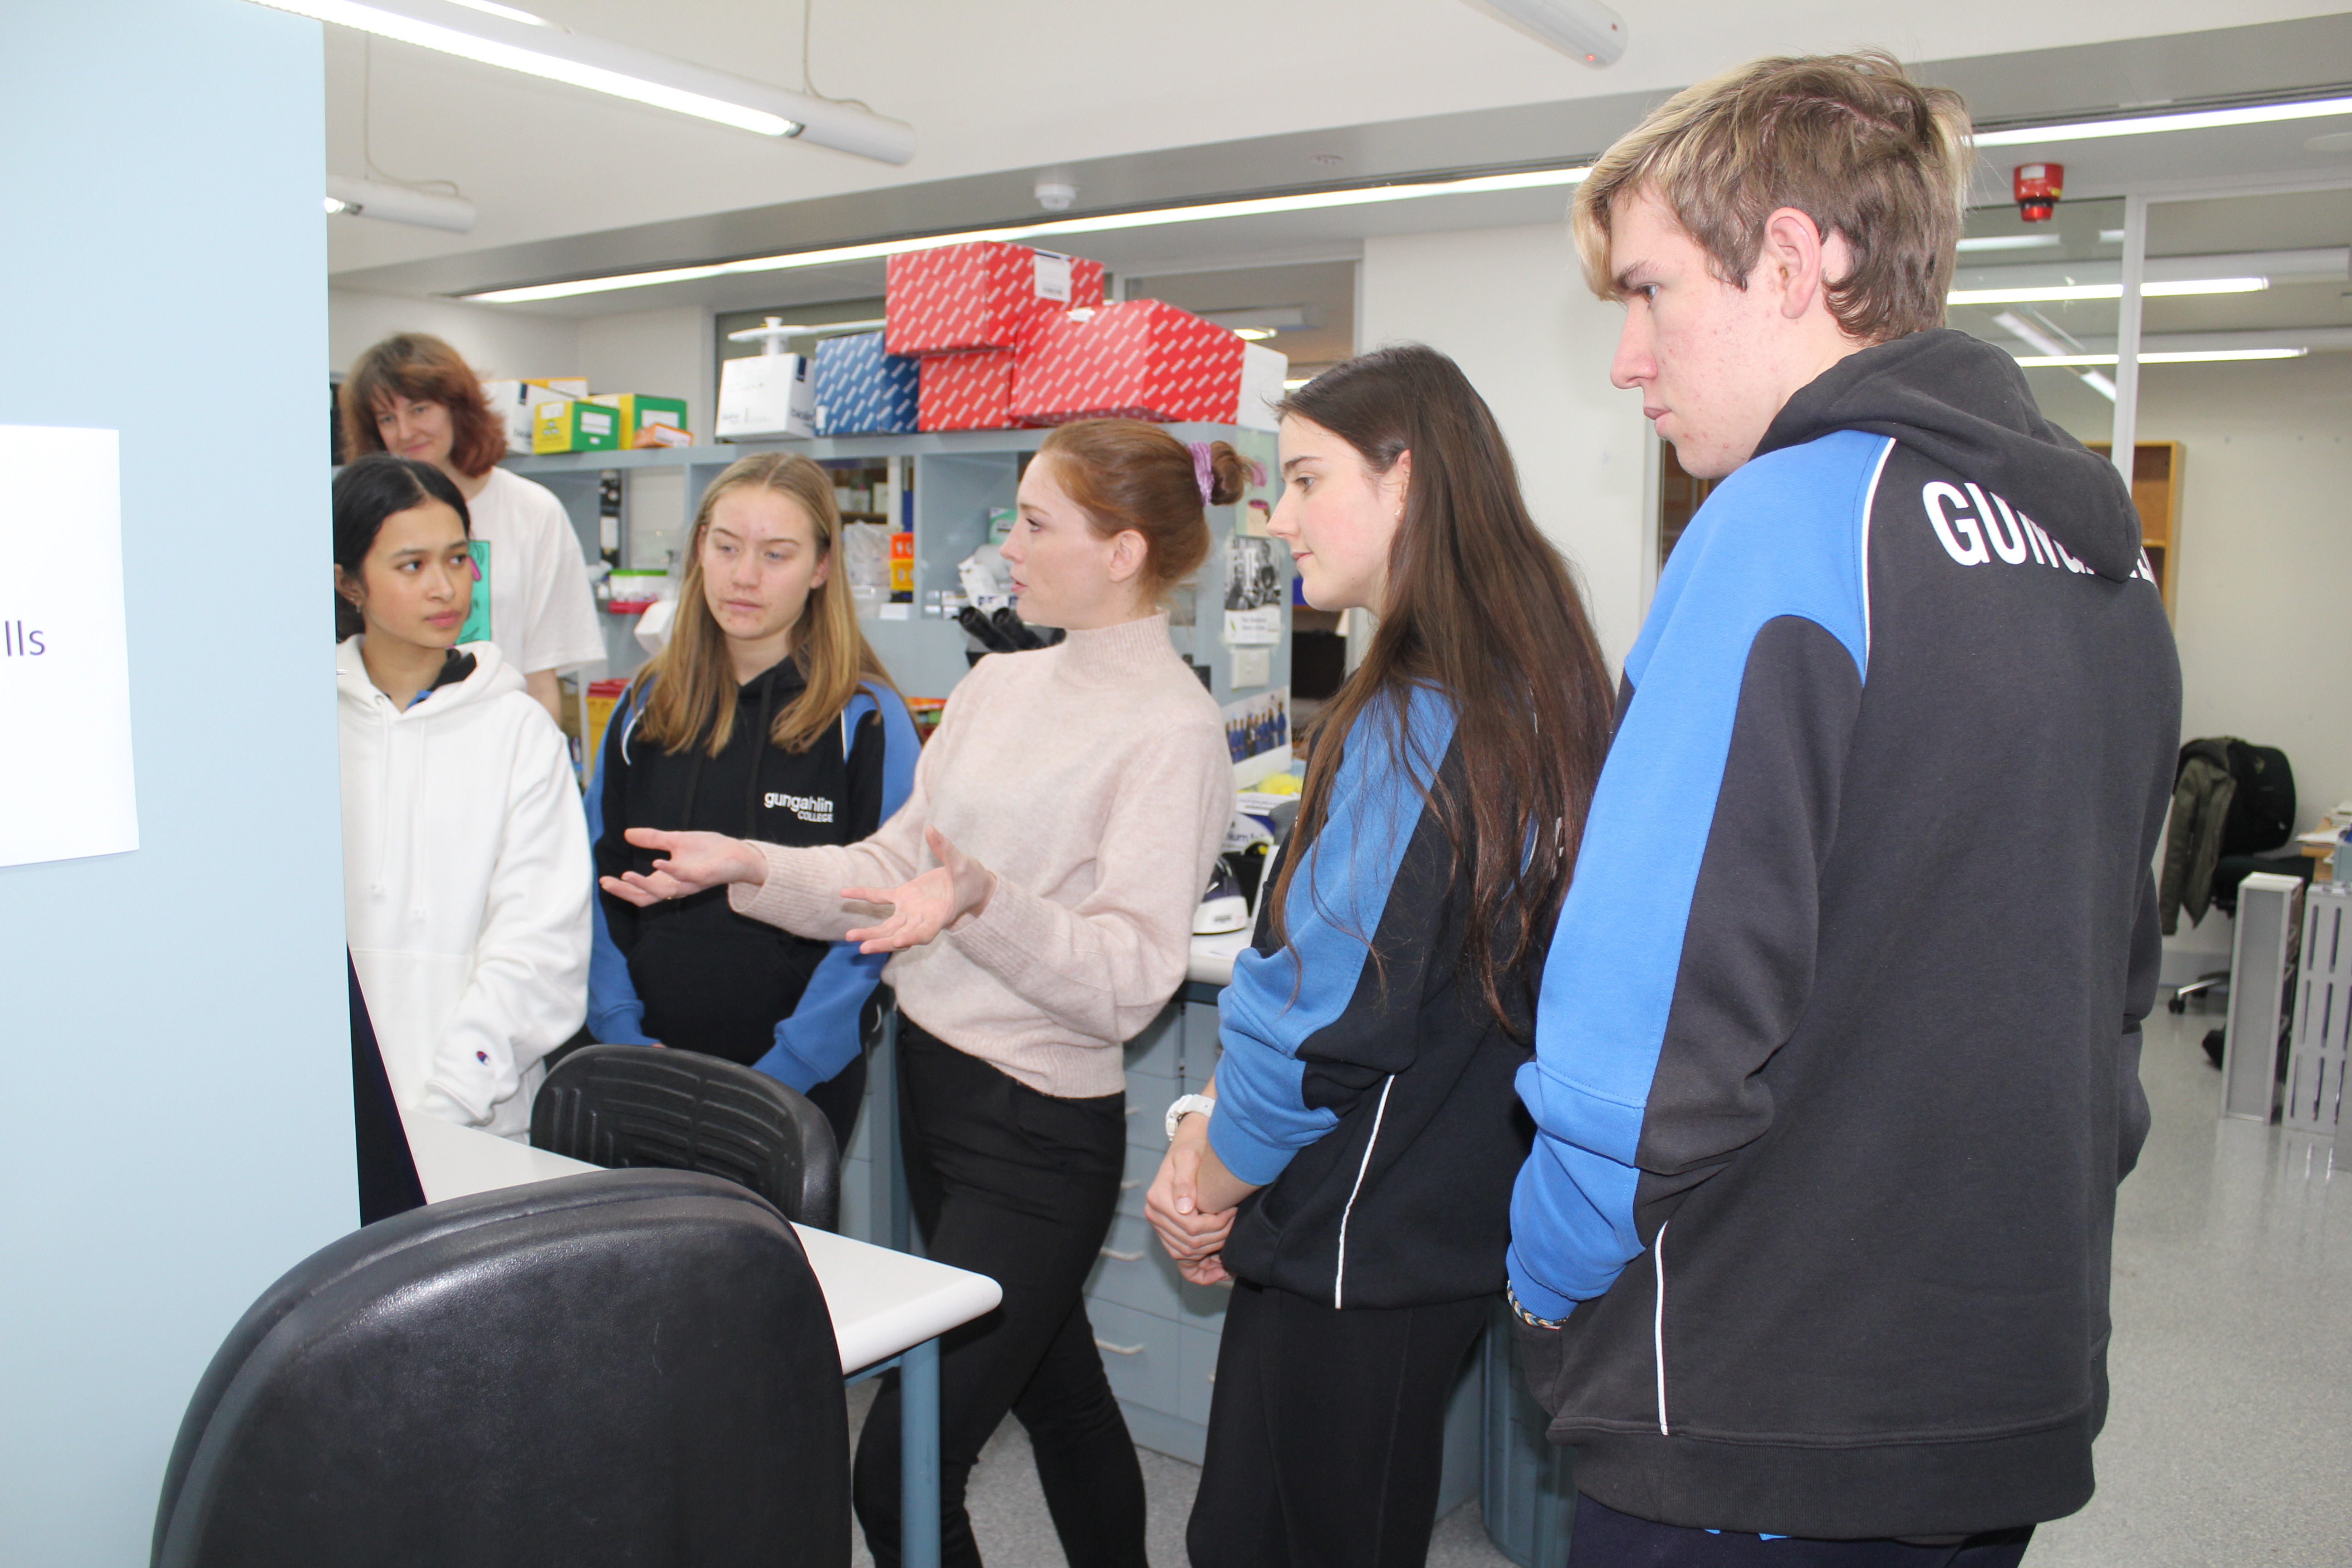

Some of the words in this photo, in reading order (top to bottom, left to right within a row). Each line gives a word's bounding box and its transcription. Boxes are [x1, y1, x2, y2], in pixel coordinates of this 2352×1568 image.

[5, 620, 46, 657] lls
[764, 792, 834, 813] gungahlin
[797, 810, 834, 823] COLLEGE
